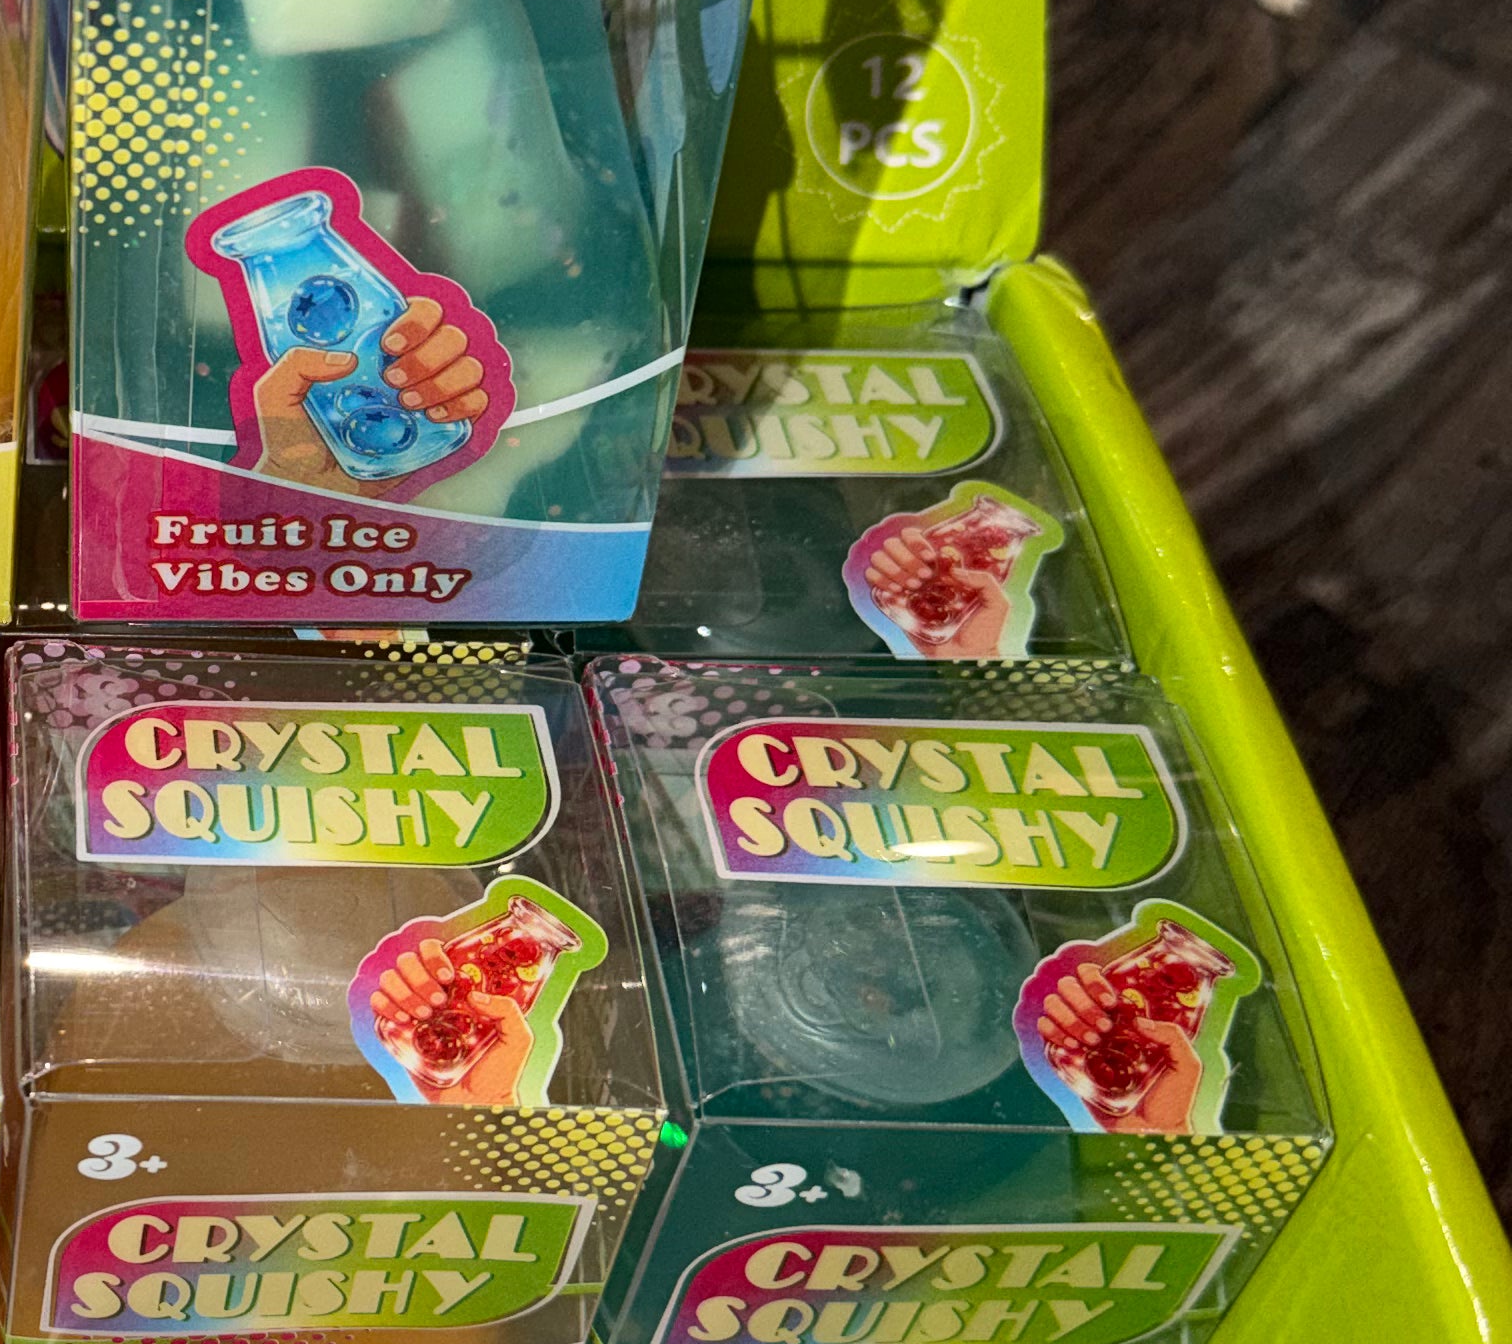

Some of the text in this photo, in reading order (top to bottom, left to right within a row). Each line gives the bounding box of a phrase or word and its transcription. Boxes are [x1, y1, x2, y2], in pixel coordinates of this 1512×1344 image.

[862, 56, 927, 103] 12
[838, 117, 945, 169] PCS
[680, 364, 966, 406] RYSTAL
[670, 414, 943, 460] QUISHY
[153, 515, 410, 549] Fruit Ice
[151, 561, 466, 599] Vibes Only
[123, 717, 525, 778] CRYSTAL
[736, 733, 1145, 799] CRYSTAL
[101, 780, 492, 848] SQUISHY
[727, 796, 1122, 870] SQUISHY
[77, 1133, 168, 1181] 3+
[734, 1163, 828, 1208] 3+
[107, 1212, 541, 1264] CRYSTAL
[743, 1241, 1168, 1294] CRYSTAL
[71, 1270, 495, 1322] SQUISHY
[687, 1295, 1115, 1344] SQUISHY
